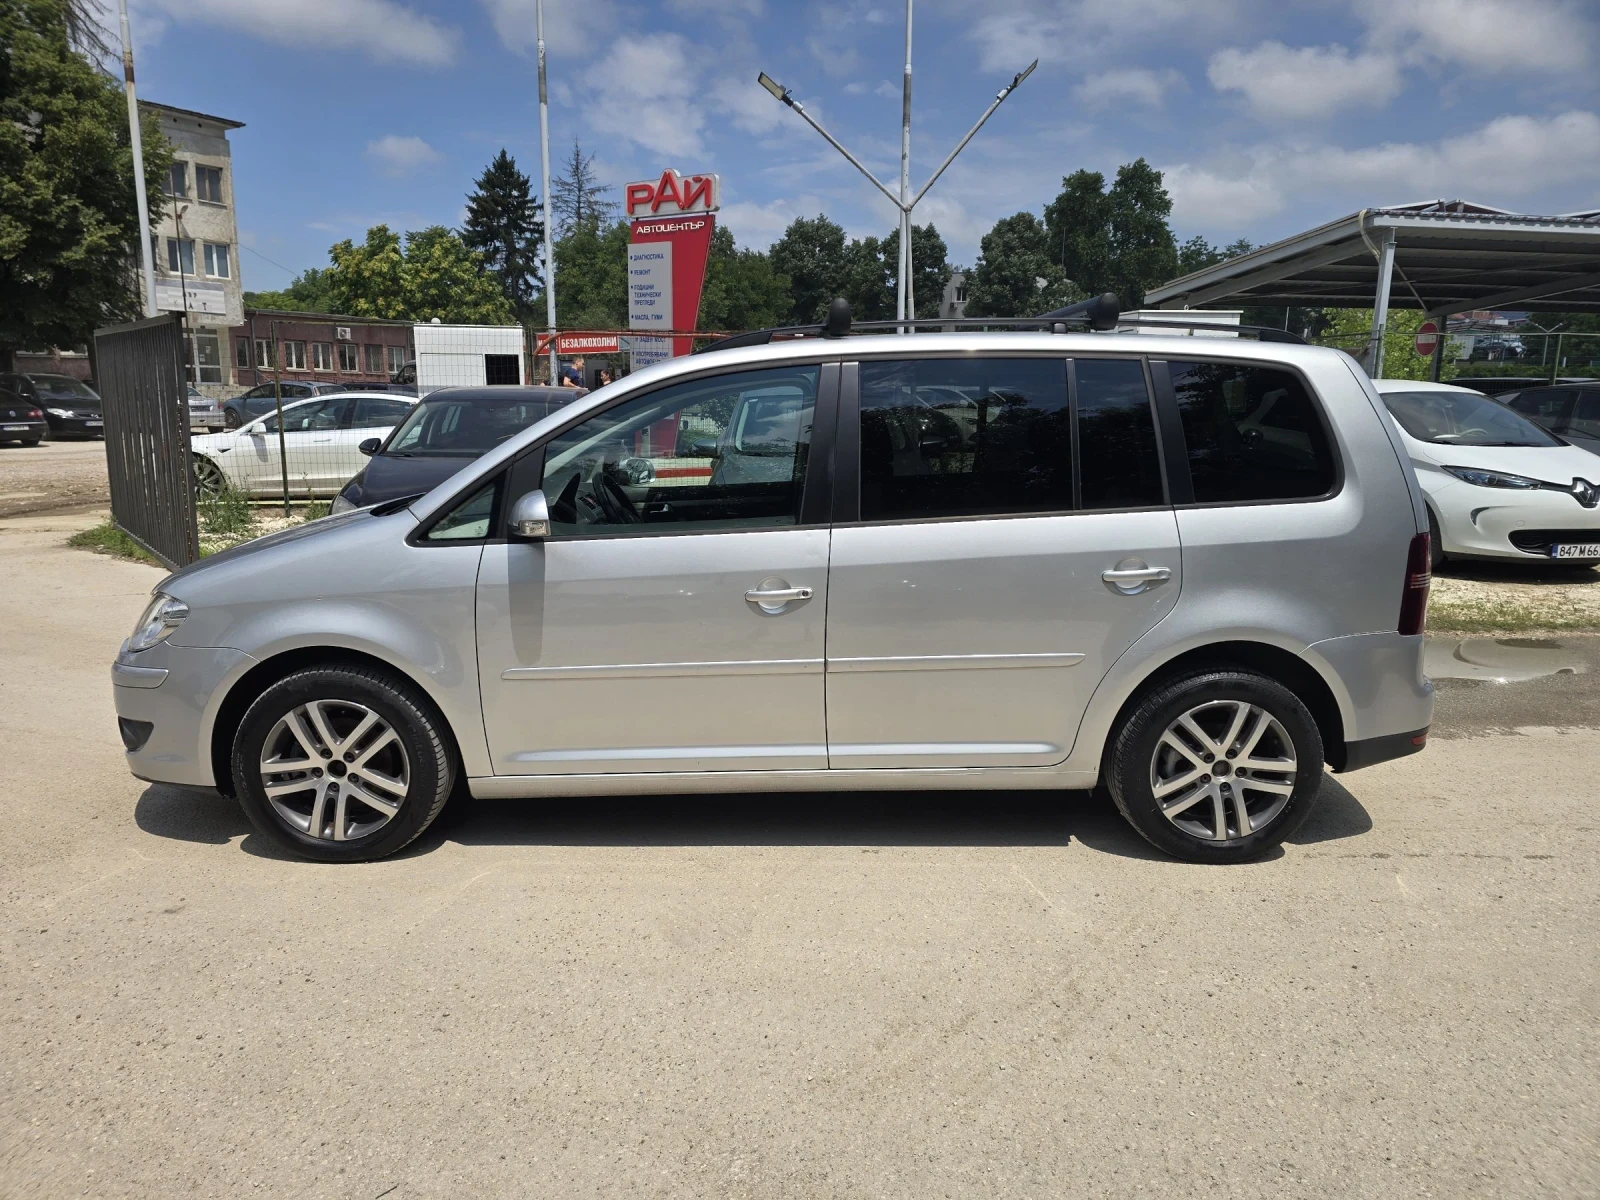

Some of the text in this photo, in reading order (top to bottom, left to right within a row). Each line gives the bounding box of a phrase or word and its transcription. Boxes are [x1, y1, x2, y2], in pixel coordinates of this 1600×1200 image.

[627, 171, 712, 215] РАЙ
[636, 221, 705, 234] АВТОЦЕНТЪР
[633, 253, 664, 261] ДИАГНОСТИКА
[561, 336, 617, 349] БЕЗАЛКОХОЛНИ
